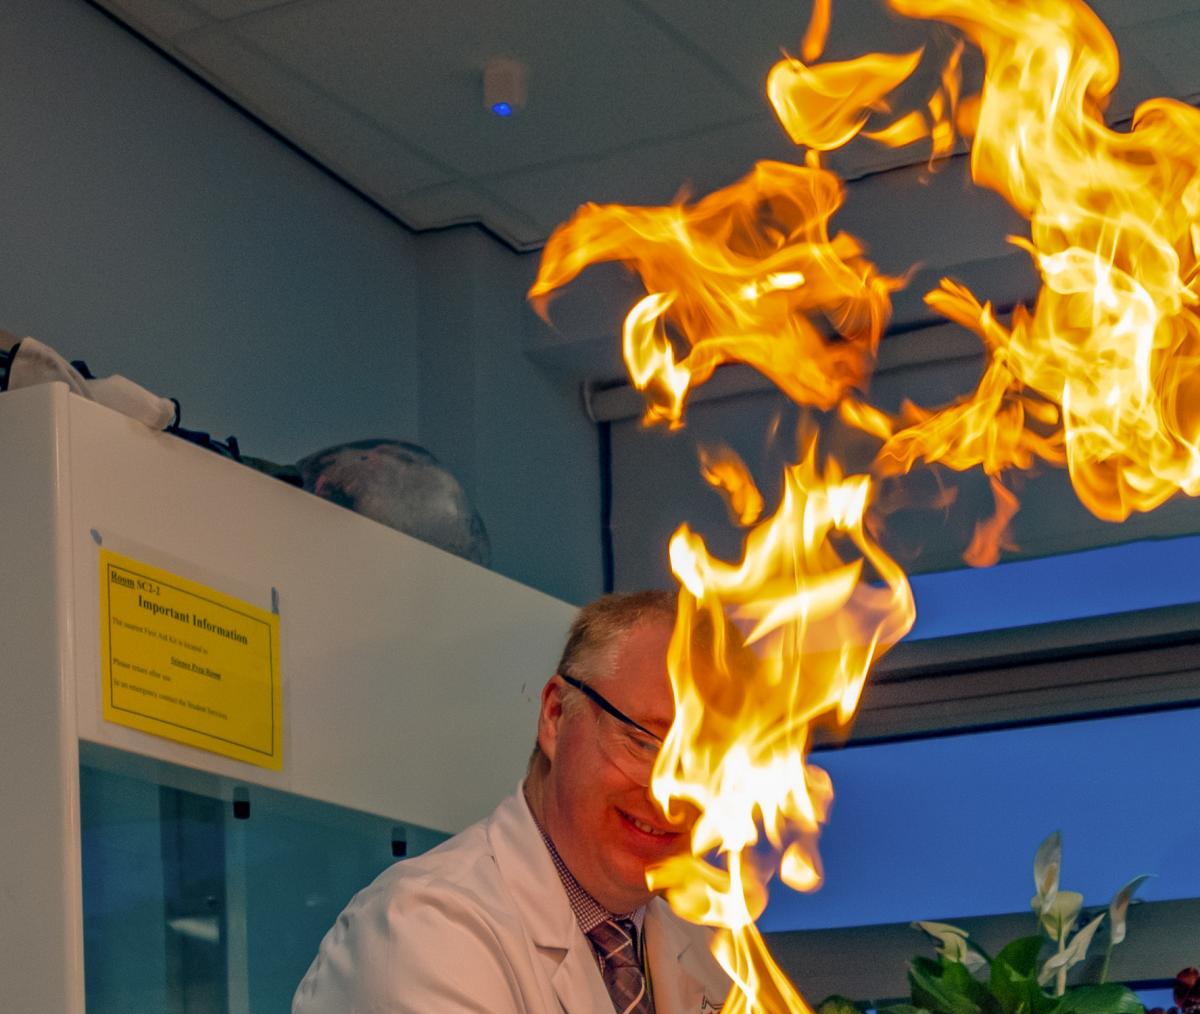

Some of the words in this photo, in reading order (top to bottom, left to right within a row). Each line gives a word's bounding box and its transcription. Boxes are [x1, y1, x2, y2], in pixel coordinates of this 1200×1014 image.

[111, 571, 134, 589] Room
[138, 595, 189, 624] Important
[192, 614, 247, 646] Information
